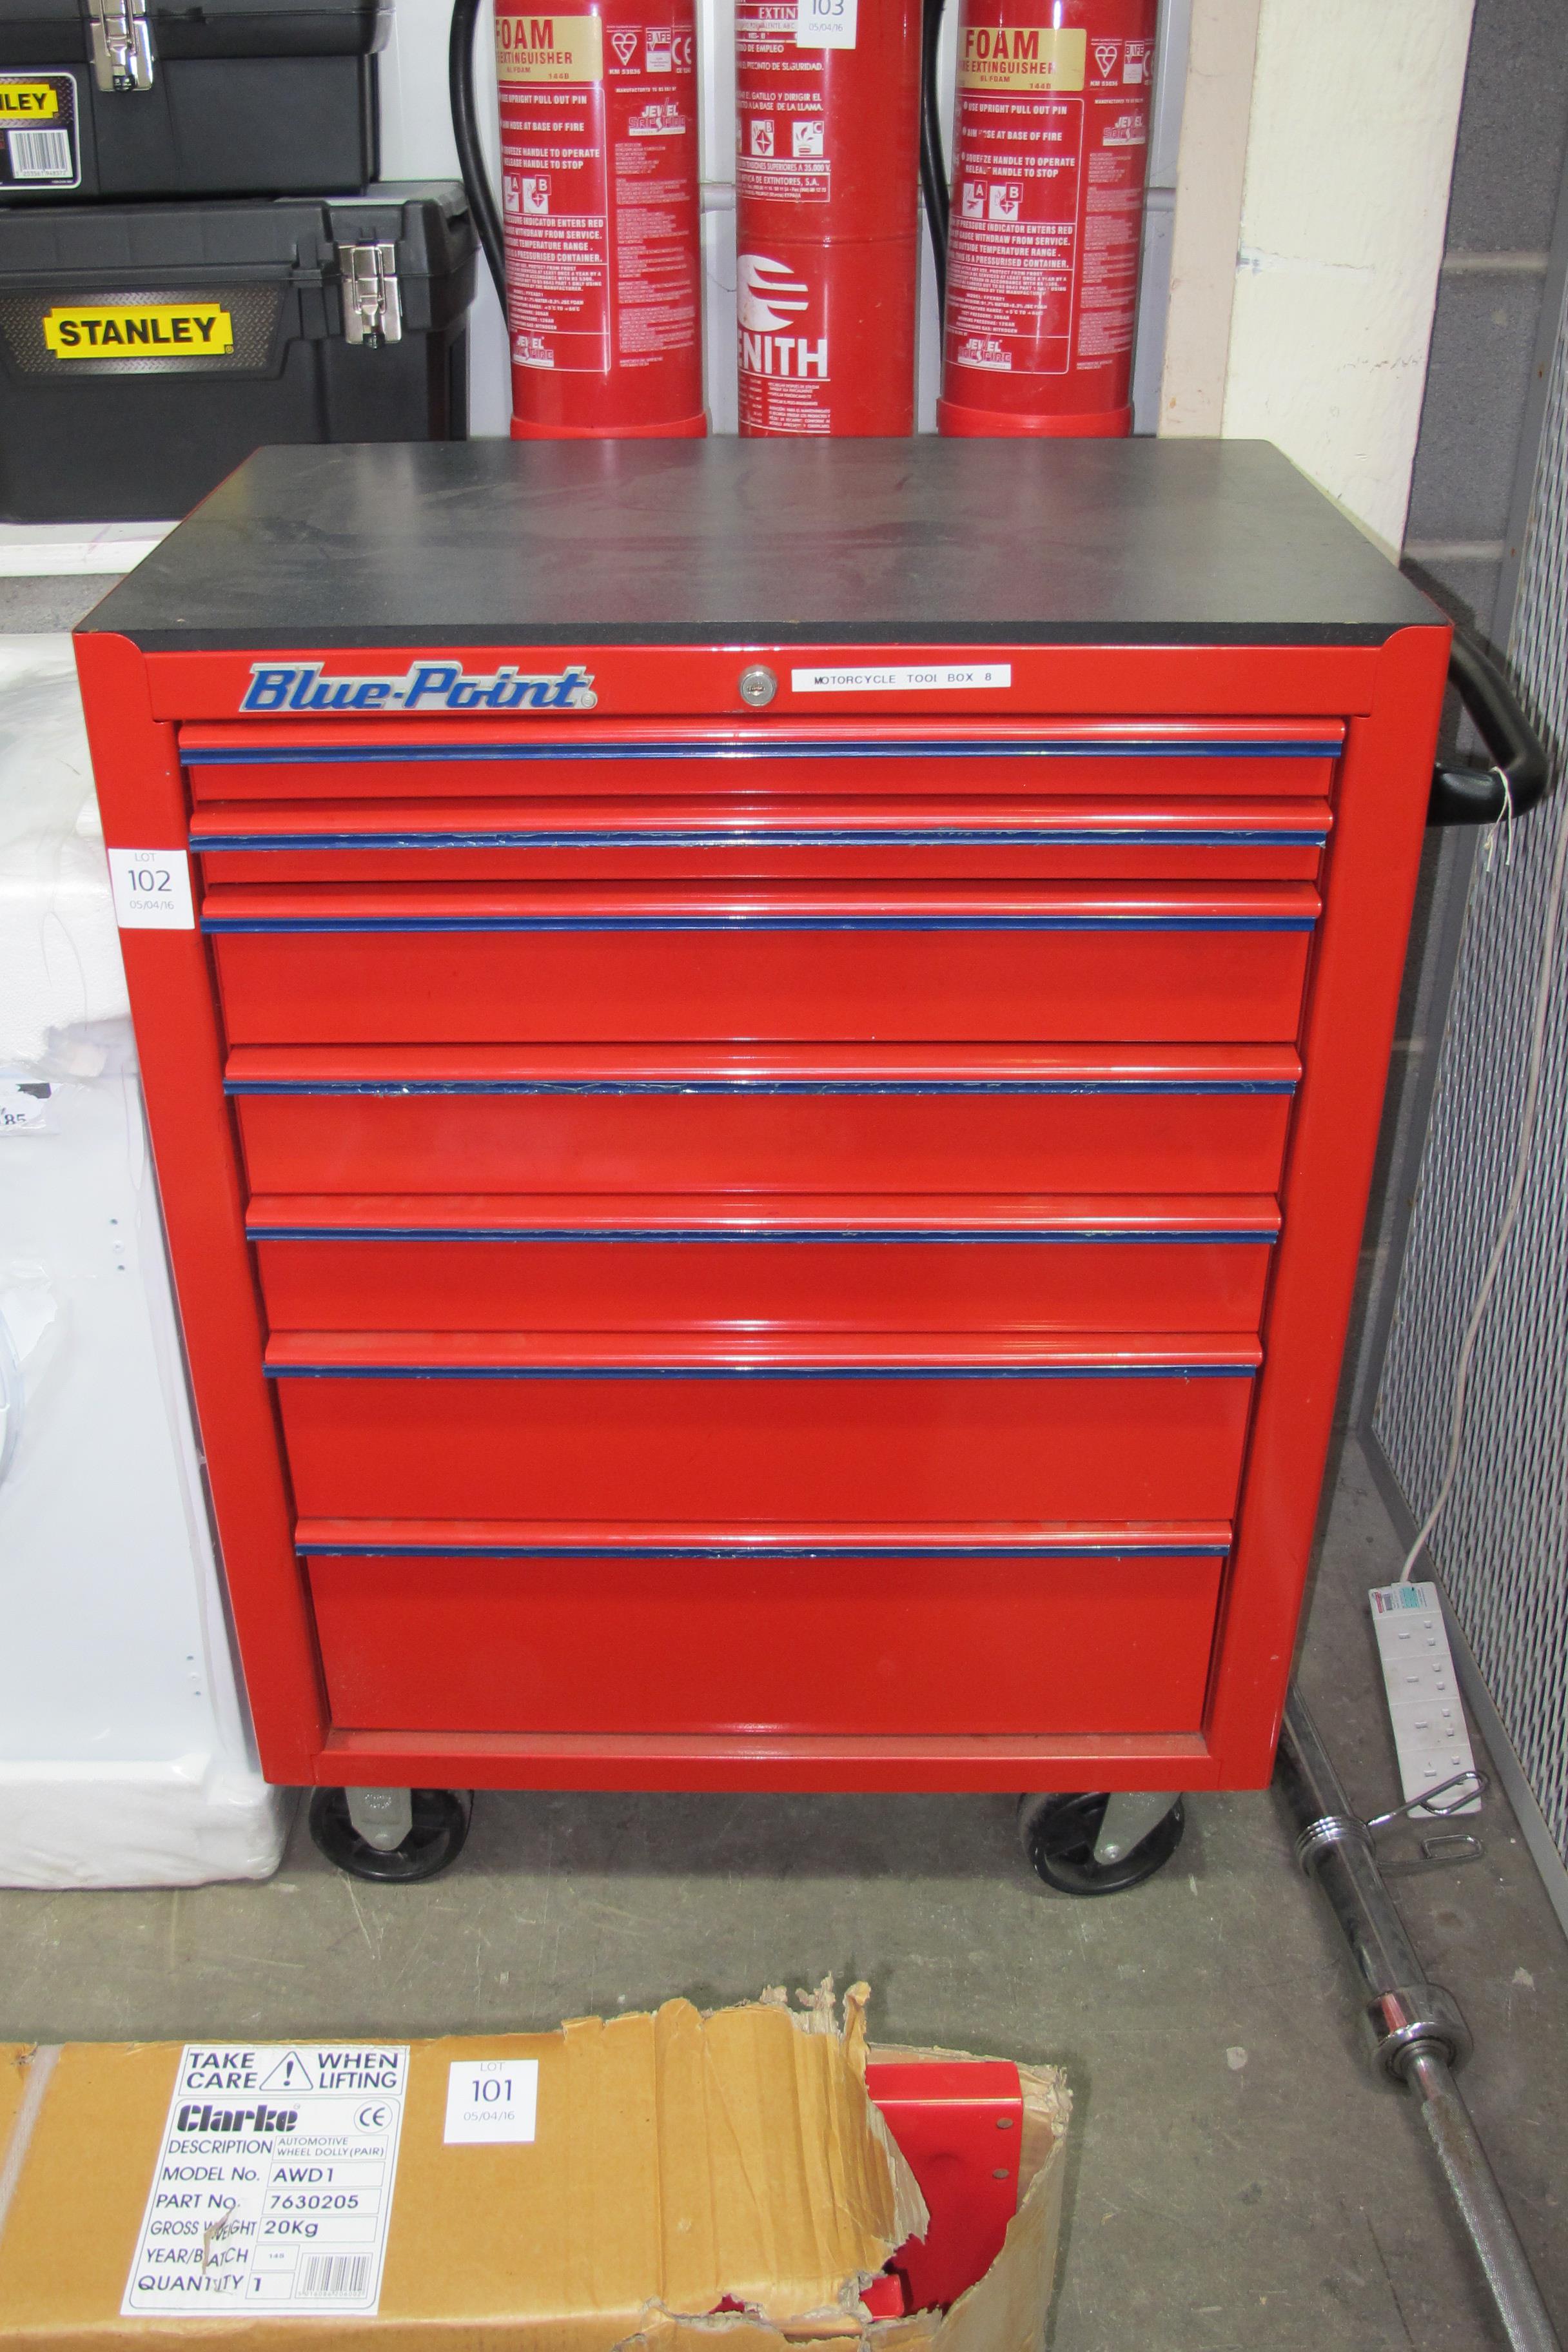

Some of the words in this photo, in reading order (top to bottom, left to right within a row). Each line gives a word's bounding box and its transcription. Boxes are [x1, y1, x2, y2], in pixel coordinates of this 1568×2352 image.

[759, 7, 798, 20] EXTIN
[812, 0, 844, 15] 103
[809, 23, 843, 32] 05/04/16
[756, 44, 784, 53] EMPLEO
[965, 29, 1039, 59] FOAM
[500, 52, 573, 64] EXTINGUISHER
[0, 93, 47, 110] LEY
[534, 95, 552, 104] PULL
[554, 95, 569, 104] OUT
[572, 95, 587, 104] PIN
[752, 92, 776, 101] GATILLO
[784, 93, 810, 101] DIRIGIR
[777, 103, 785, 111] DE
[979, 104, 1009, 113] UPRIGHT
[1011, 105, 1031, 114] PULL
[1033, 106, 1050, 114] OUT
[1052, 106, 1067, 115] PIN
[524, 122, 531, 130] AT
[533, 122, 551, 131] BASE
[553, 122, 563, 131] OF
[565, 122, 584, 132] FIRE
[767, 122, 772, 132] B
[814, 122, 822, 133] C
[967, 128, 977, 137] AIM
[997, 131, 1006, 139] AT
[1007, 131, 1028, 140] BASE
[1030, 132, 1041, 141] OF
[1043, 132, 1063, 141] FIRE
[523, 147, 548, 157] HANDLE
[550, 148, 560, 157] TO
[562, 149, 600, 157] OPERATE
[523, 159, 548, 168] HANDLE
[550, 160, 560, 169] TO
[562, 161, 584, 170] STOP
[993, 155, 1023, 166] HANDLE
[1025, 157, 1035, 166] TO
[1037, 157, 1075, 166] OPERATE
[992, 167, 1022, 177] HANDLE
[1024, 168, 1035, 177] TO
[1037, 169, 1059, 178] STOP
[513, 177, 518, 189] A
[539, 180, 547, 191] B
[975, 184, 984, 196] A
[1010, 186, 1019, 198] B
[558, 219, 586, 228] ENTERS
[588, 219, 603, 228] RED
[987, 223, 1024, 233] INDICATOR
[1027, 225, 1056, 234] ENTERS
[1058, 226, 1073, 235] RED
[545, 230, 564, 239] FROM
[567, 231, 602, 239] SERVICE.
[975, 233, 1010, 244] WITHDRAW
[1012, 236, 1033, 245] FROM
[1035, 237, 1070, 246] SERVICE.
[519, 239, 562, 250] TEMPERATURE
[564, 242, 588, 251] RANGE
[980, 244, 1029, 256] TEMPERATURE
[1031, 248, 1057, 257] RANGE
[557, 253, 603, 262] CONTAINER.
[976, 255, 1021, 267] PRESSURISED
[1024, 259, 1069, 268] CONTAINER.
[59, 317, 216, 347] STANLEY
[814, 674, 896, 685] MOTORCYCLE
[948, 673, 974, 683] BOX
[985, 672, 992, 682] 8
[241, 663, 590, 710] Blue-Point
[135, 852, 156, 862] LOT
[128, 870, 172, 892] 102
[130, 900, 175, 910] 05/04/16
[189, 2052, 256, 2069] TAKE
[317, 2052, 399, 2070] WHEN
[480, 2063, 505, 2072] LOT
[186, 2072, 257, 2089] CARE
[319, 2072, 397, 2089] LIFTING
[472, 2079, 512, 2102] 101
[176, 2104, 299, 2132] Clarke
[358, 2107, 386, 2128] CE
[464, 2111, 515, 2121] 05/04/16
[168, 2139, 273, 2155] DESCRIPTION
[278, 2137, 349, 2146] AUTOMOTIVE
[277, 2147, 311, 2157] WHEEL
[315, 2147, 349, 2157] DOLLY
[349, 2147, 385, 2158] (PAIR)
[162, 2166, 225, 2181] MODEL
[231, 2167, 261, 2181] No.
[273, 2167, 334, 2183] AWD1
[155, 2193, 202, 2208] PART
[207, 2194, 241, 2209] No.
[270, 2195, 359, 2210] 7630205
[150, 2220, 199, 2235] GROSS
[264, 2219, 319, 2238] 20Kg
[146, 2248, 249, 2268] YEAR/BATCH
[137, 2275, 244, 2293] QUANTITY
[253, 2276, 262, 2291] 1
